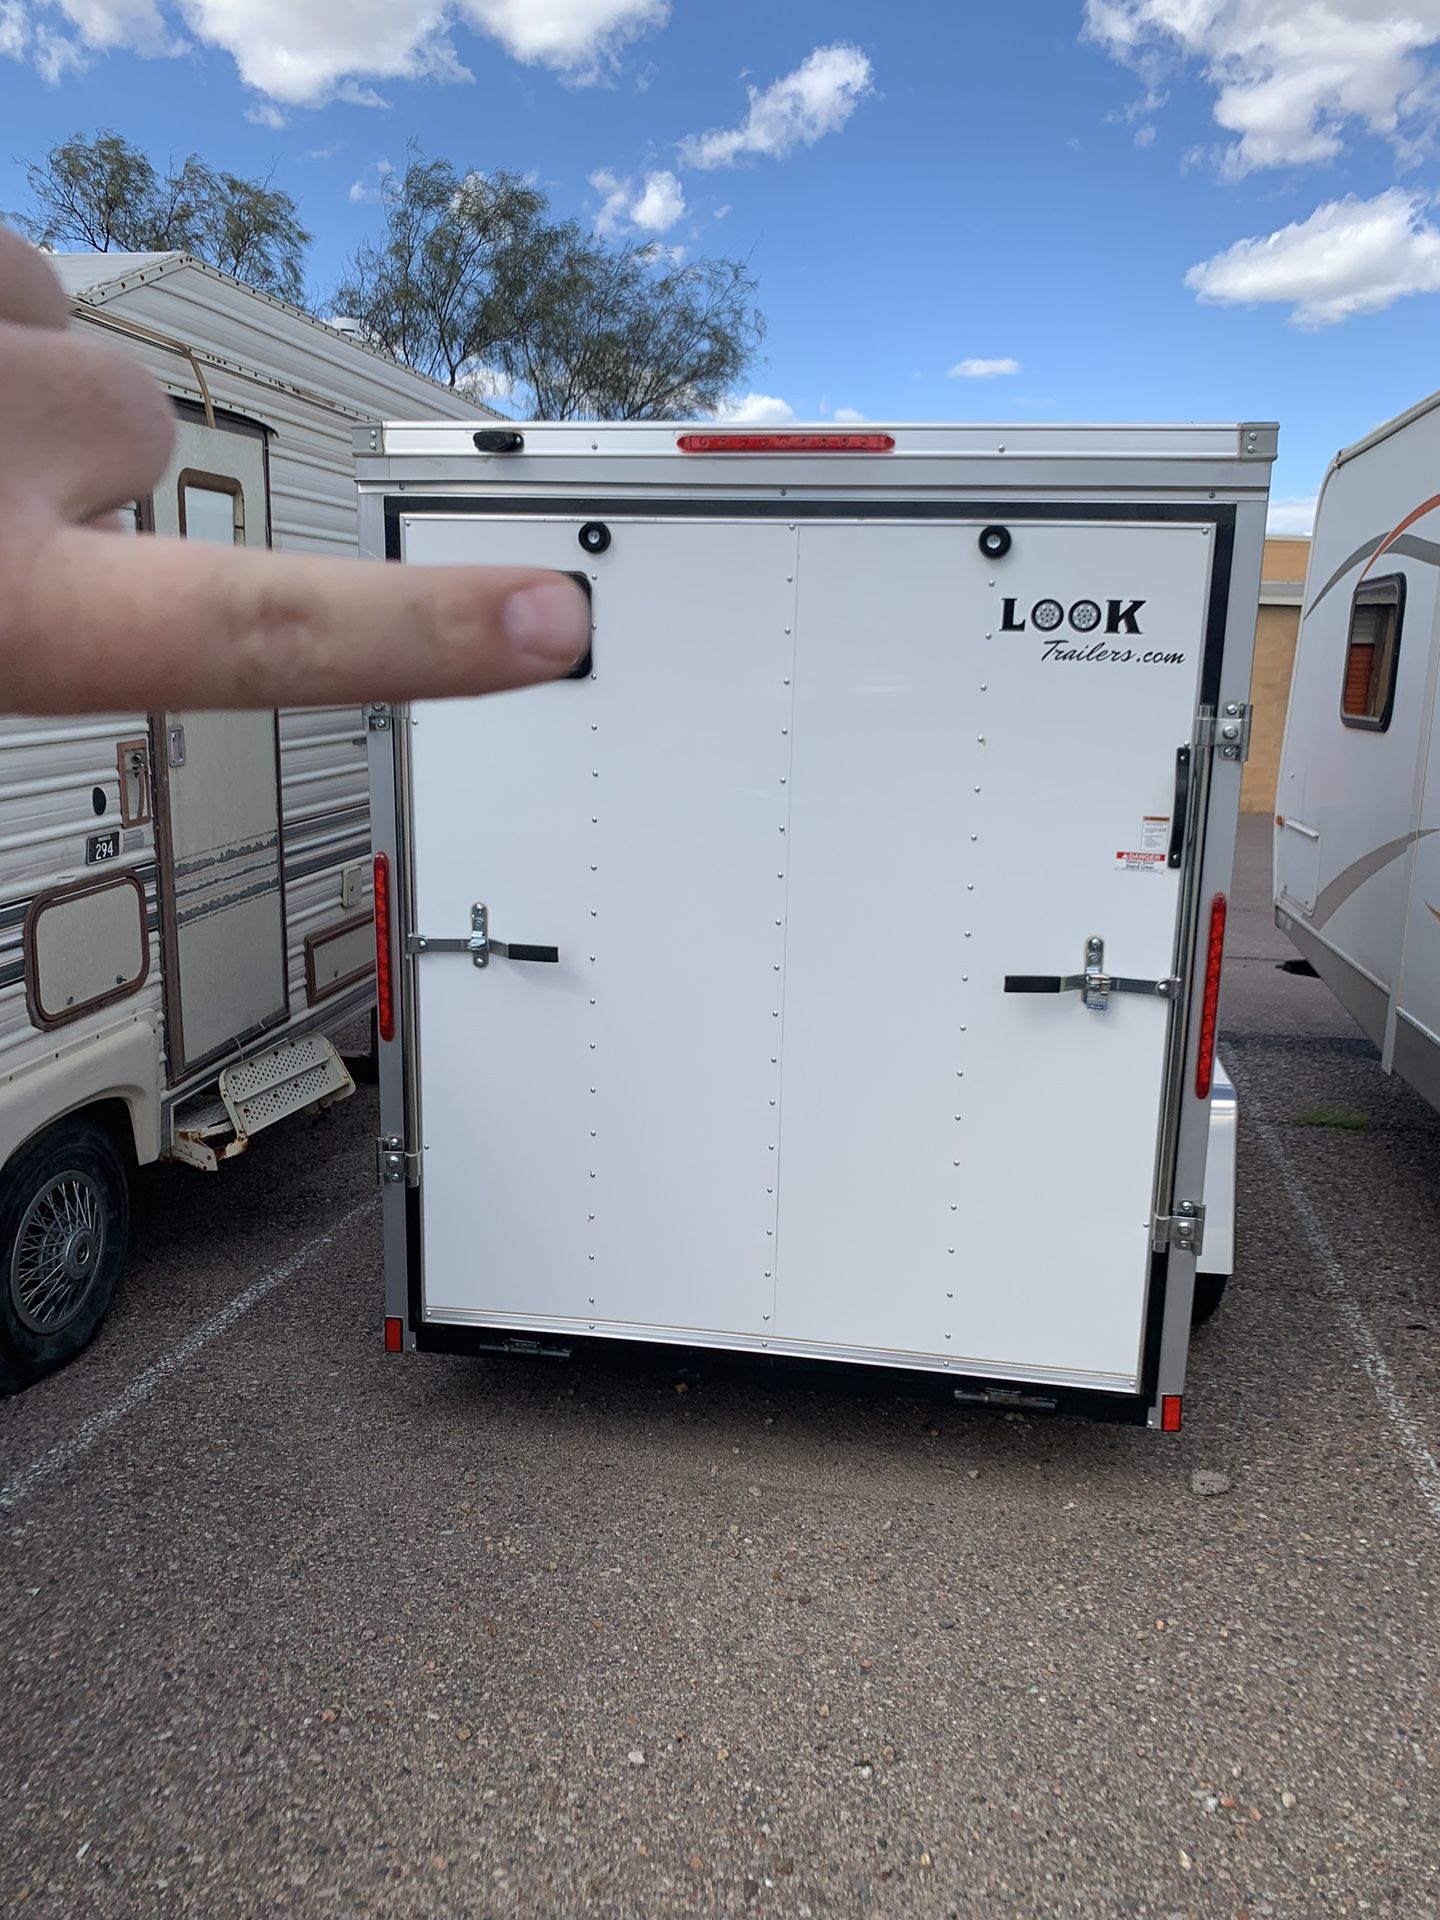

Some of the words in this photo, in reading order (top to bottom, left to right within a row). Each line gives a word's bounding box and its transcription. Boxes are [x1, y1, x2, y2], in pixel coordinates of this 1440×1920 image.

[999, 598, 1147, 635] LOOK
[1041, 639, 1186, 665] Trailers.com
[95, 840, 114, 860] 294
[1128, 852, 1161, 862] DANGER
